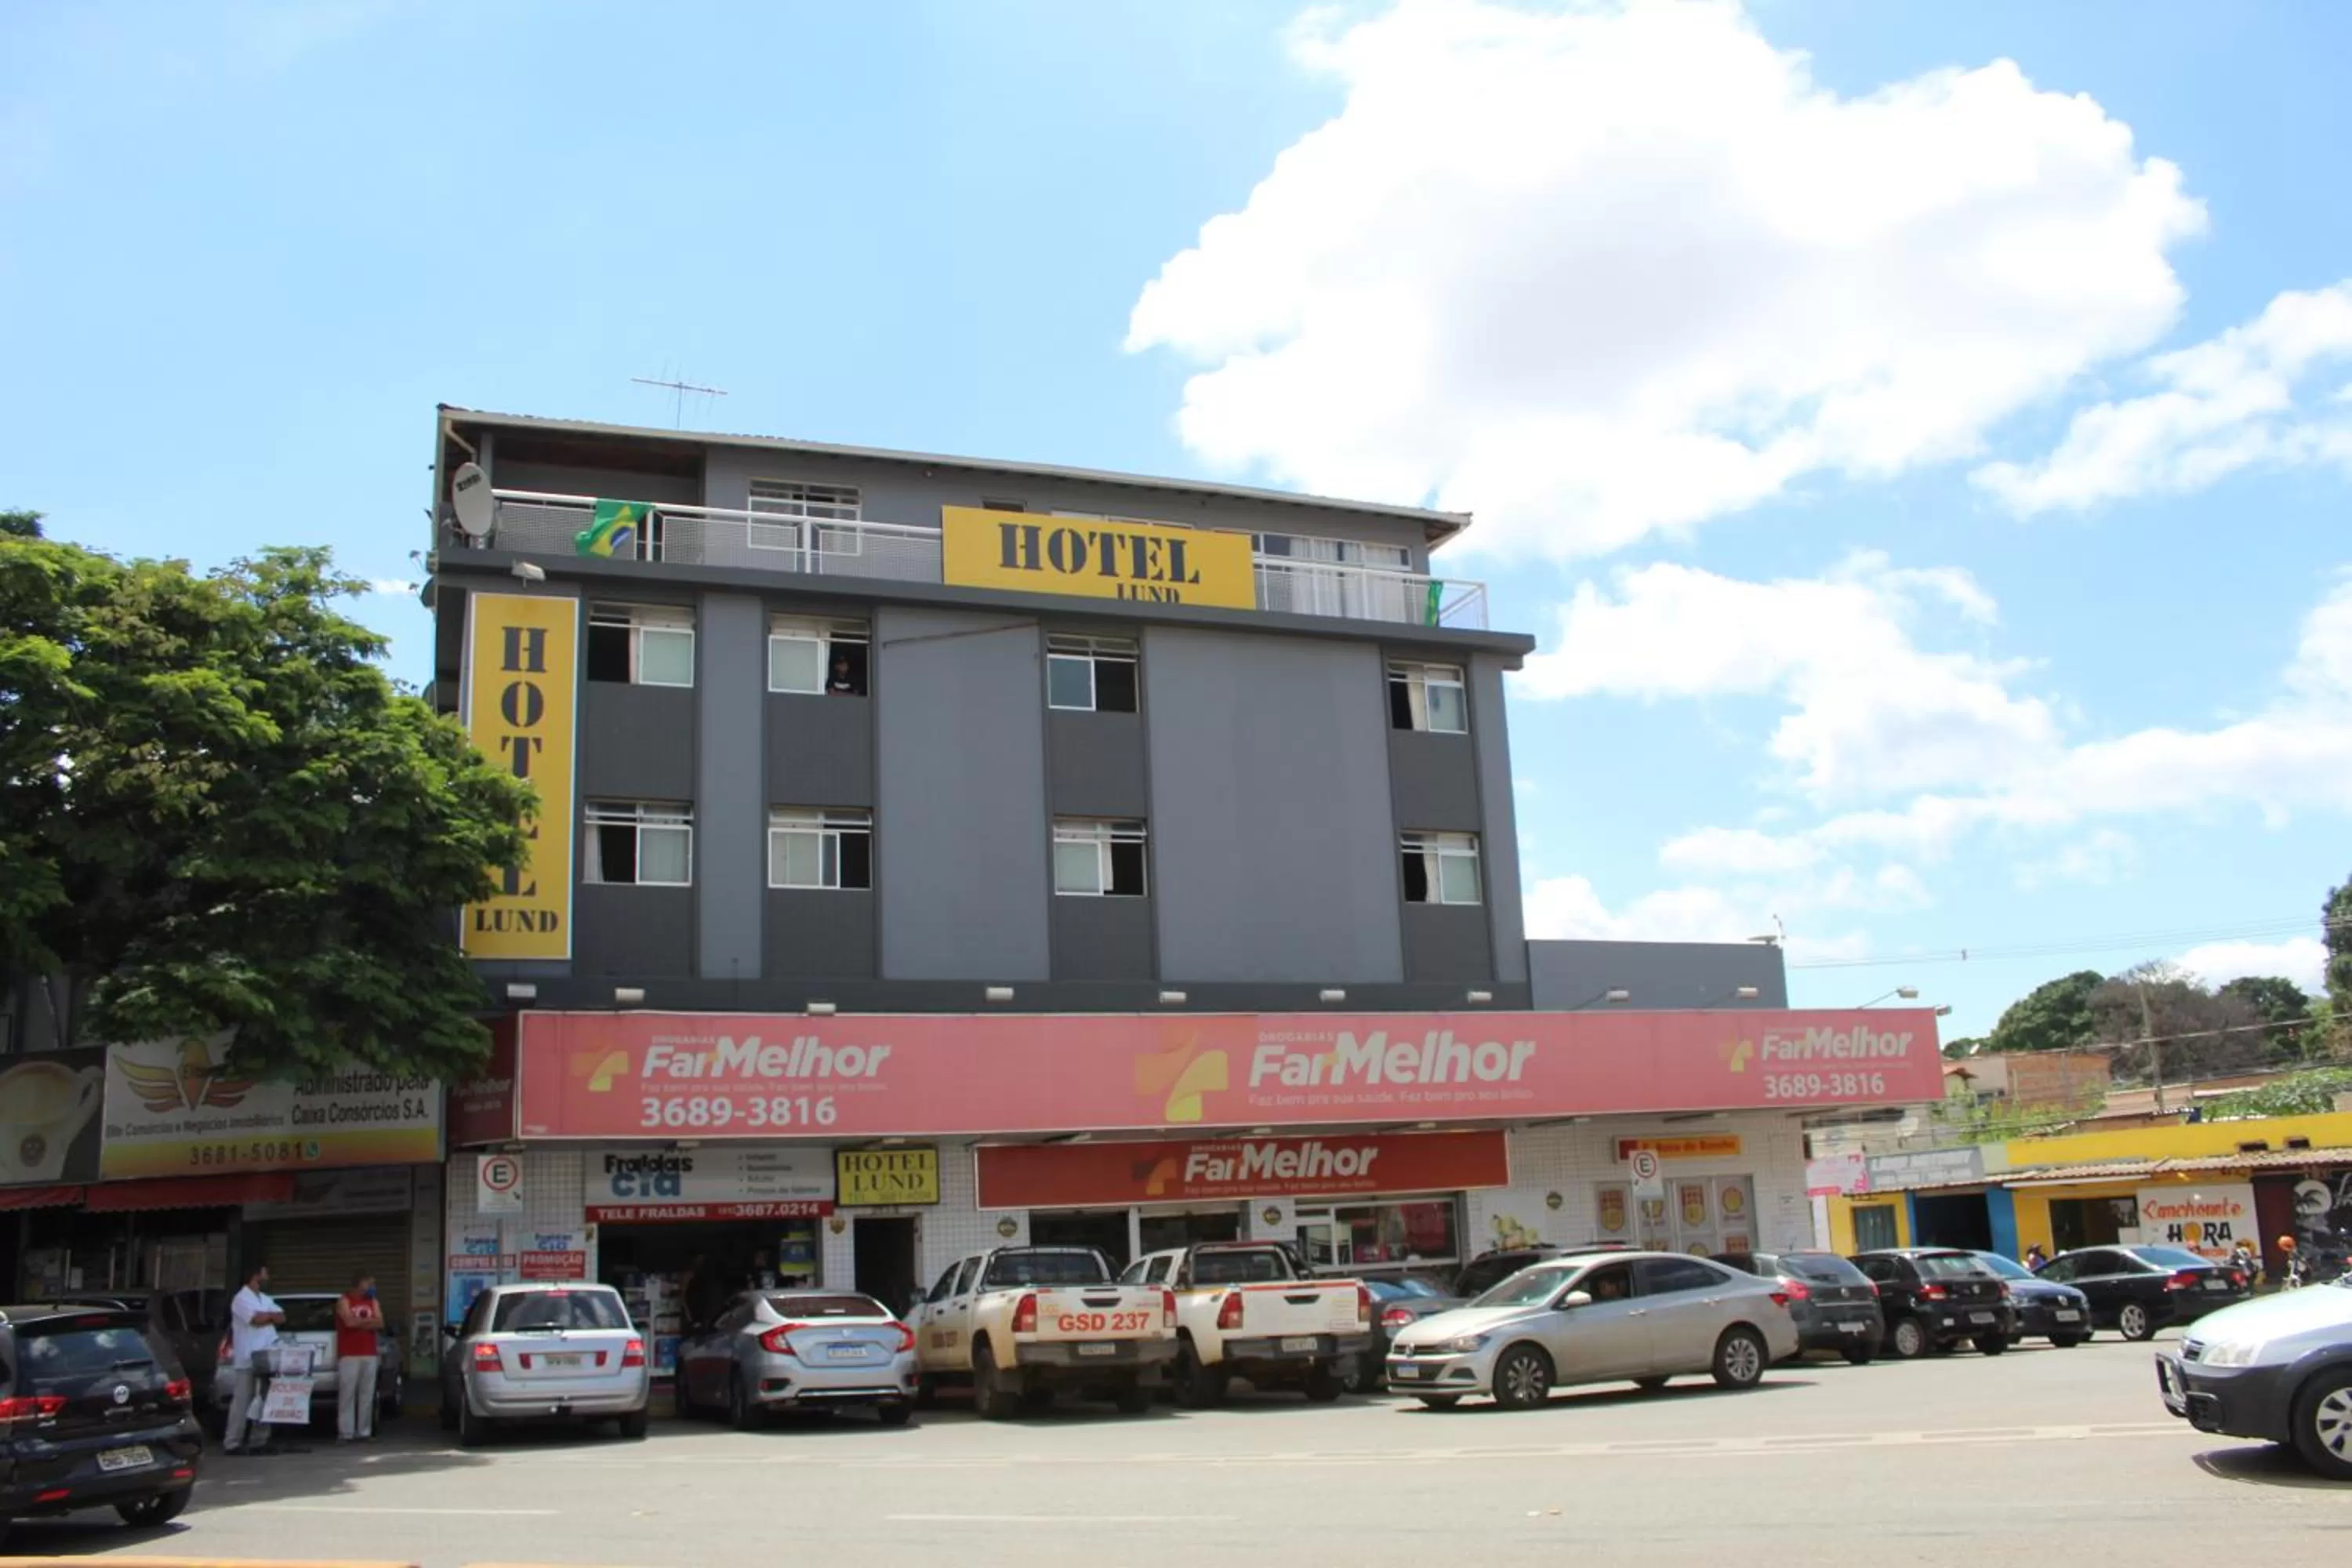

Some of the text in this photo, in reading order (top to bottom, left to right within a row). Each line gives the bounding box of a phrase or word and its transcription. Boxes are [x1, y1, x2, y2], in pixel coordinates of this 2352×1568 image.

[999, 523, 1200, 585] HOTEL
[1116, 583, 1181, 604] LUND
[500, 626, 548, 897] HOTL
[475, 909, 559, 932] LUND
[1762, 1025, 1914, 1061] FarMelhor
[642, 1036, 891, 1078] FarMelhor
[1249, 1029, 1537, 1088] FarMelhor
[1762, 1072, 1886, 1099] 3689-3816
[641, 1095, 837, 1127] 3689-3816
[190, 1142, 302, 1166] 3681-5081
[844, 1153, 934, 1173] HOTEL
[1184, 1142, 1379, 1182] FarMelhor
[1639, 1158, 1650, 1173] E
[492, 1164, 509, 1183] E
[854, 1173, 924, 1192] LUND
[598, 1208, 634, 1220] TELE
[638, 1206, 706, 1219] FRALDAS
[1058, 1312, 1150, 1331] GSD 237
